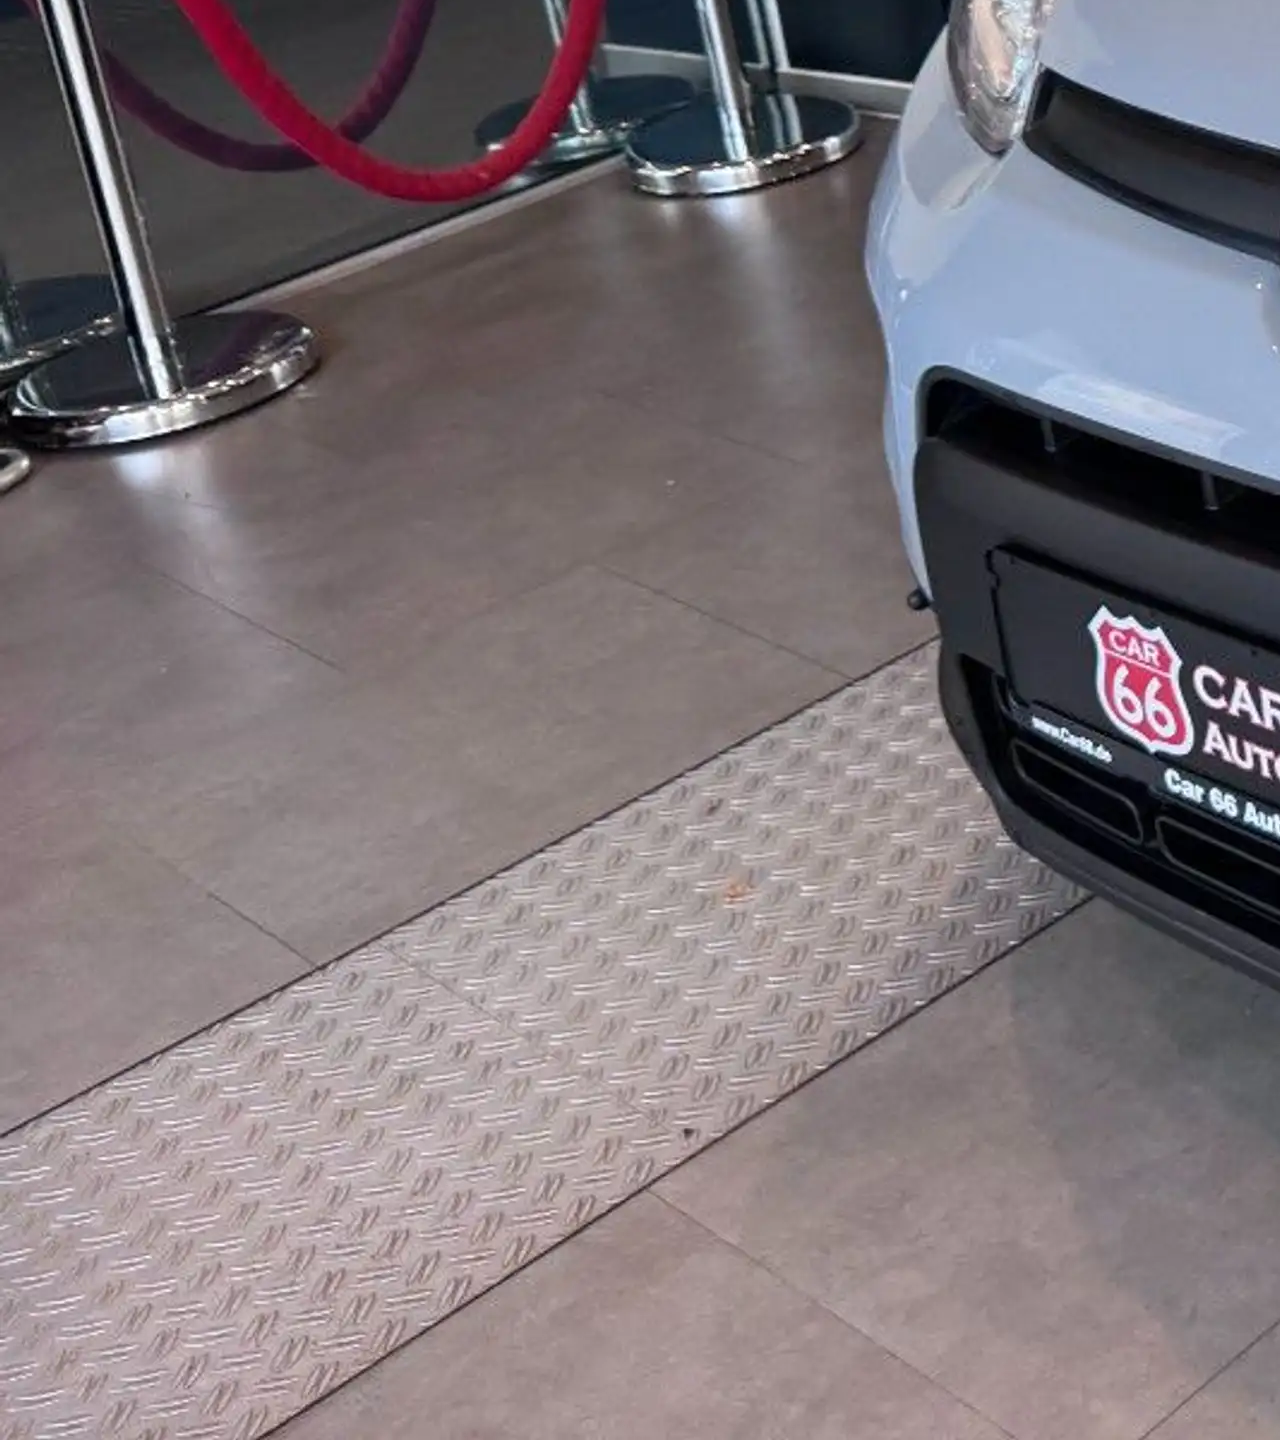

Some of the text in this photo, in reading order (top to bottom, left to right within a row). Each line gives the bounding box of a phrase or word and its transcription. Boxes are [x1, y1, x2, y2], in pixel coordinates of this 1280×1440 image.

[1108, 629, 1159, 667] CAR
[1112, 665, 1177, 739] 66
[1164, 767, 1204, 803] Car
[1208, 787, 1239, 818] 66
